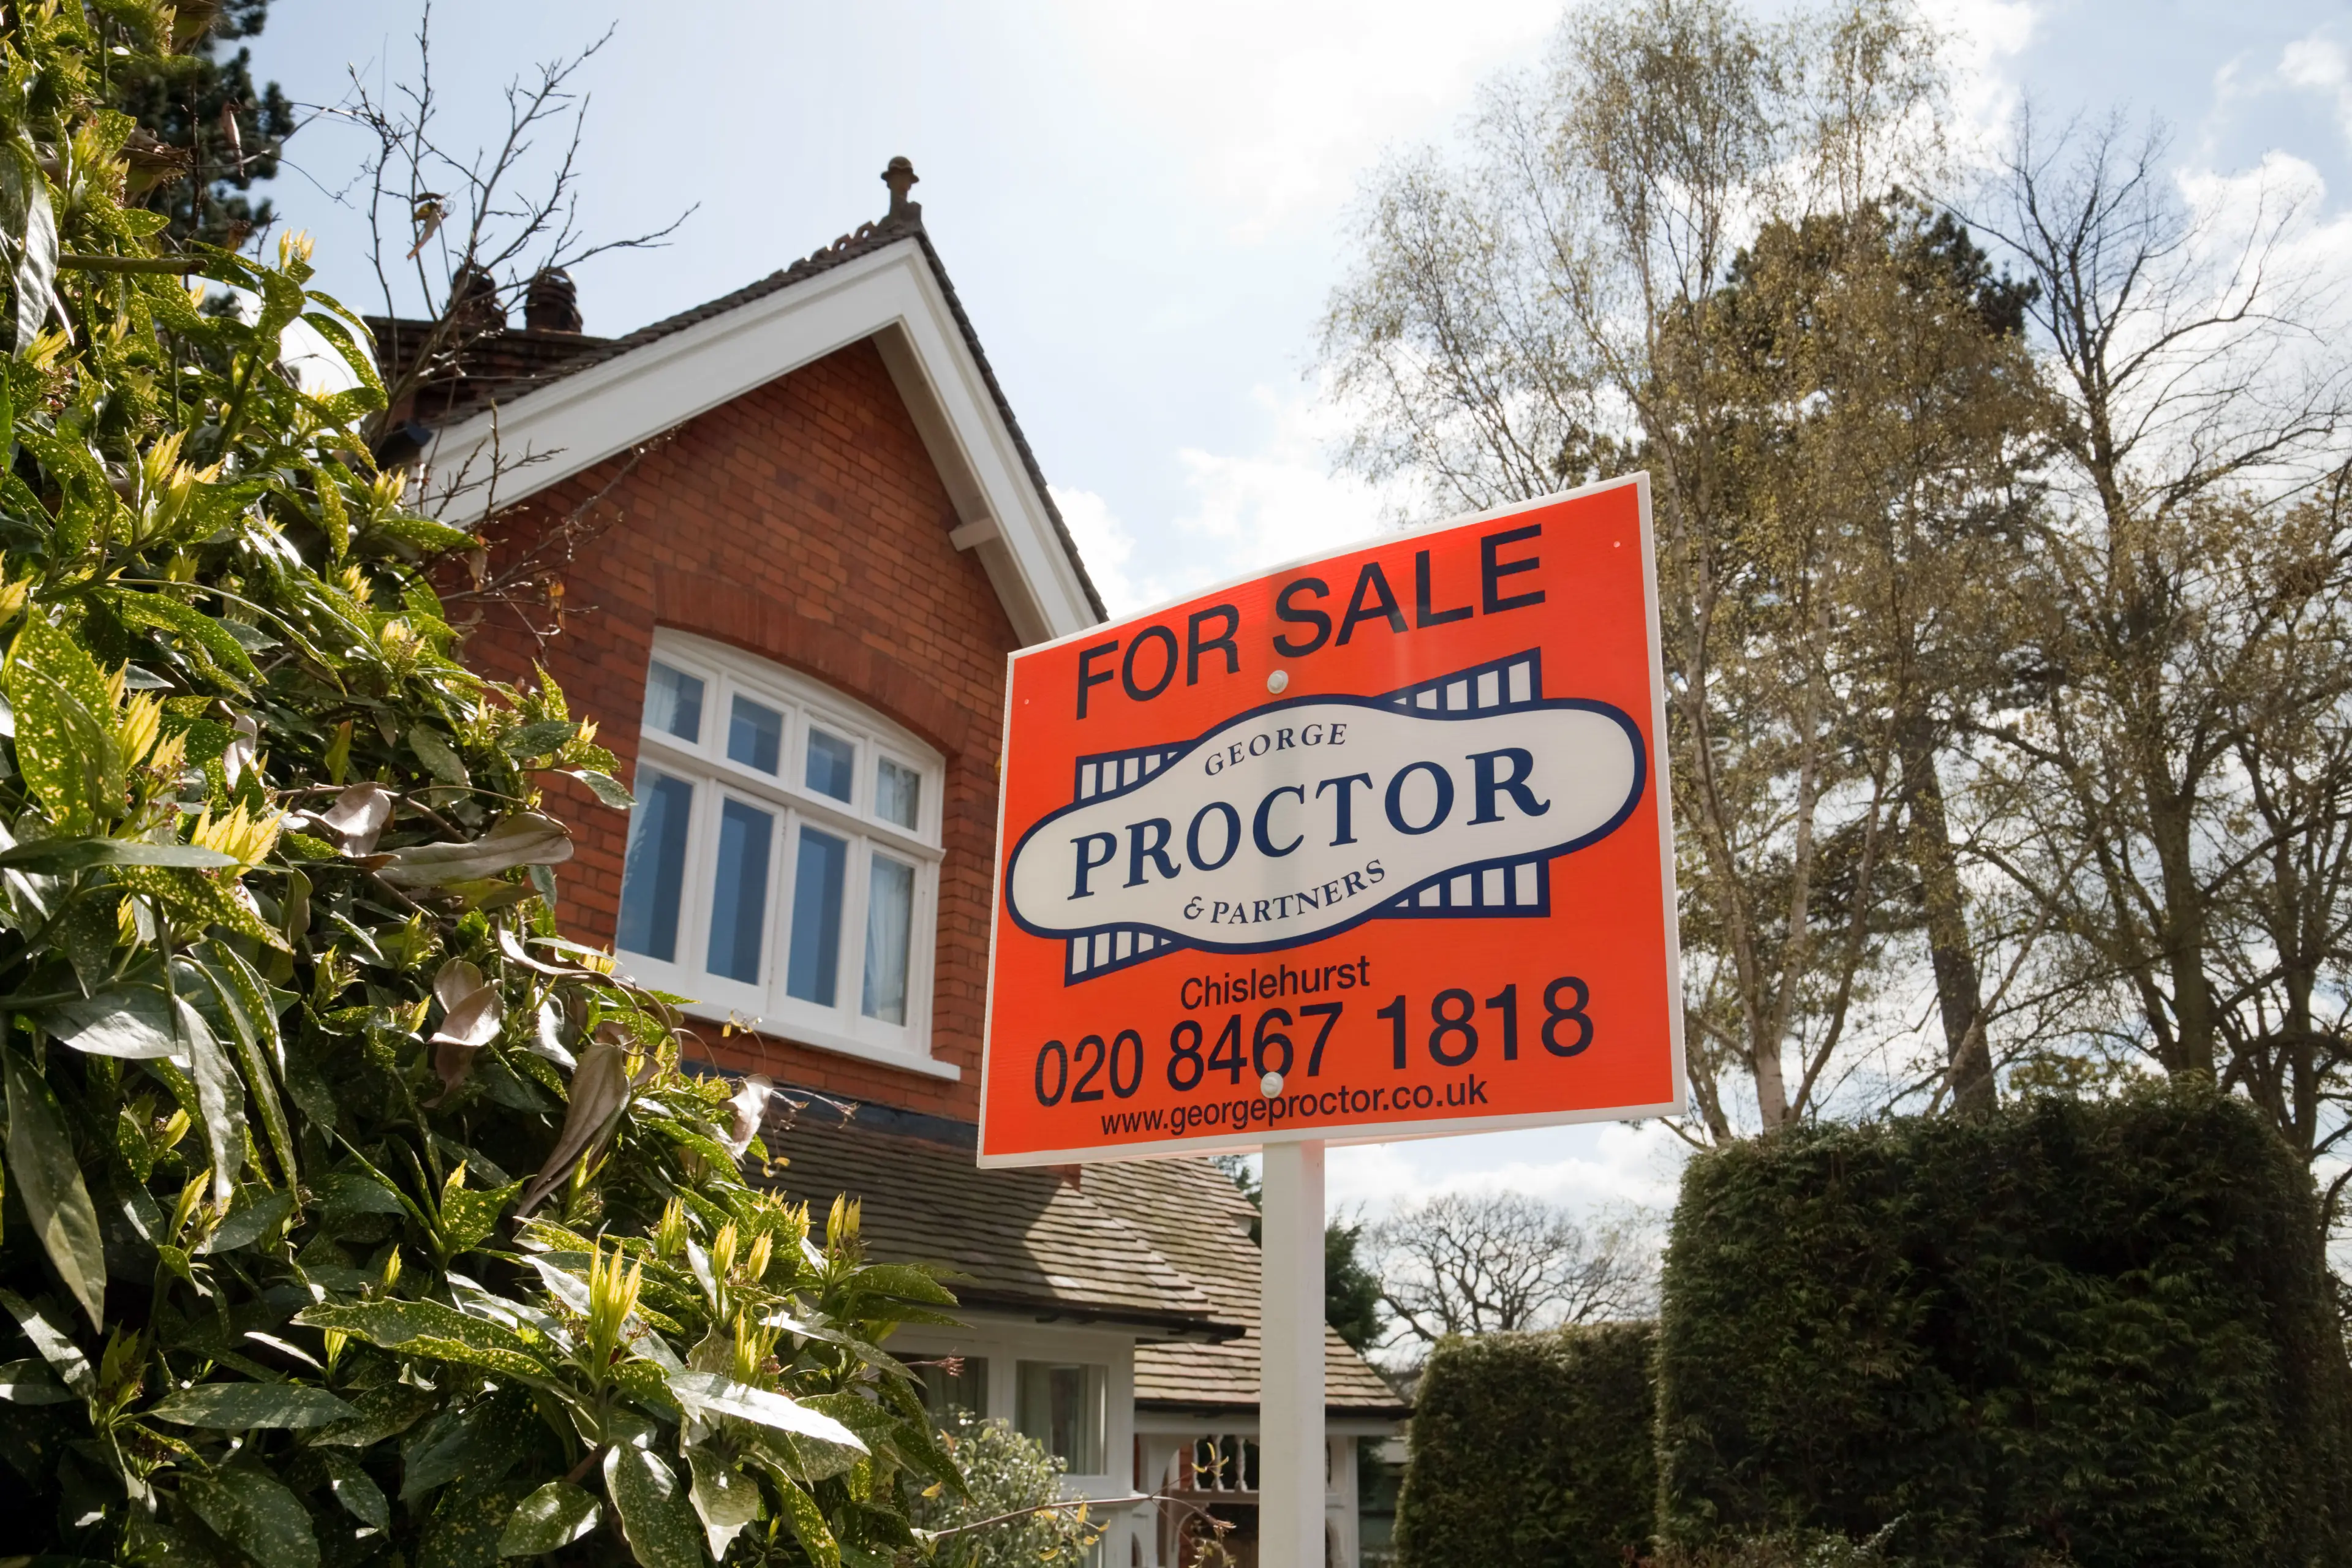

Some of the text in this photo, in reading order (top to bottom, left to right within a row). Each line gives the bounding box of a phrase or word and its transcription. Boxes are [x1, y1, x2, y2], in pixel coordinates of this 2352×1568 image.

[1076, 524, 1546, 720] FOR SALE
[1204, 723, 1348, 777] GEORGE
[1066, 747, 1551, 901] PROCTOR
[1183, 858, 1385, 925] & PARTNERS
[1180, 954, 1371, 1010] Chislehurst
[1035, 976, 1594, 1107] 020 8467 1818
[1101, 1073, 1488, 1137] www.georgeproctor.co.uk
